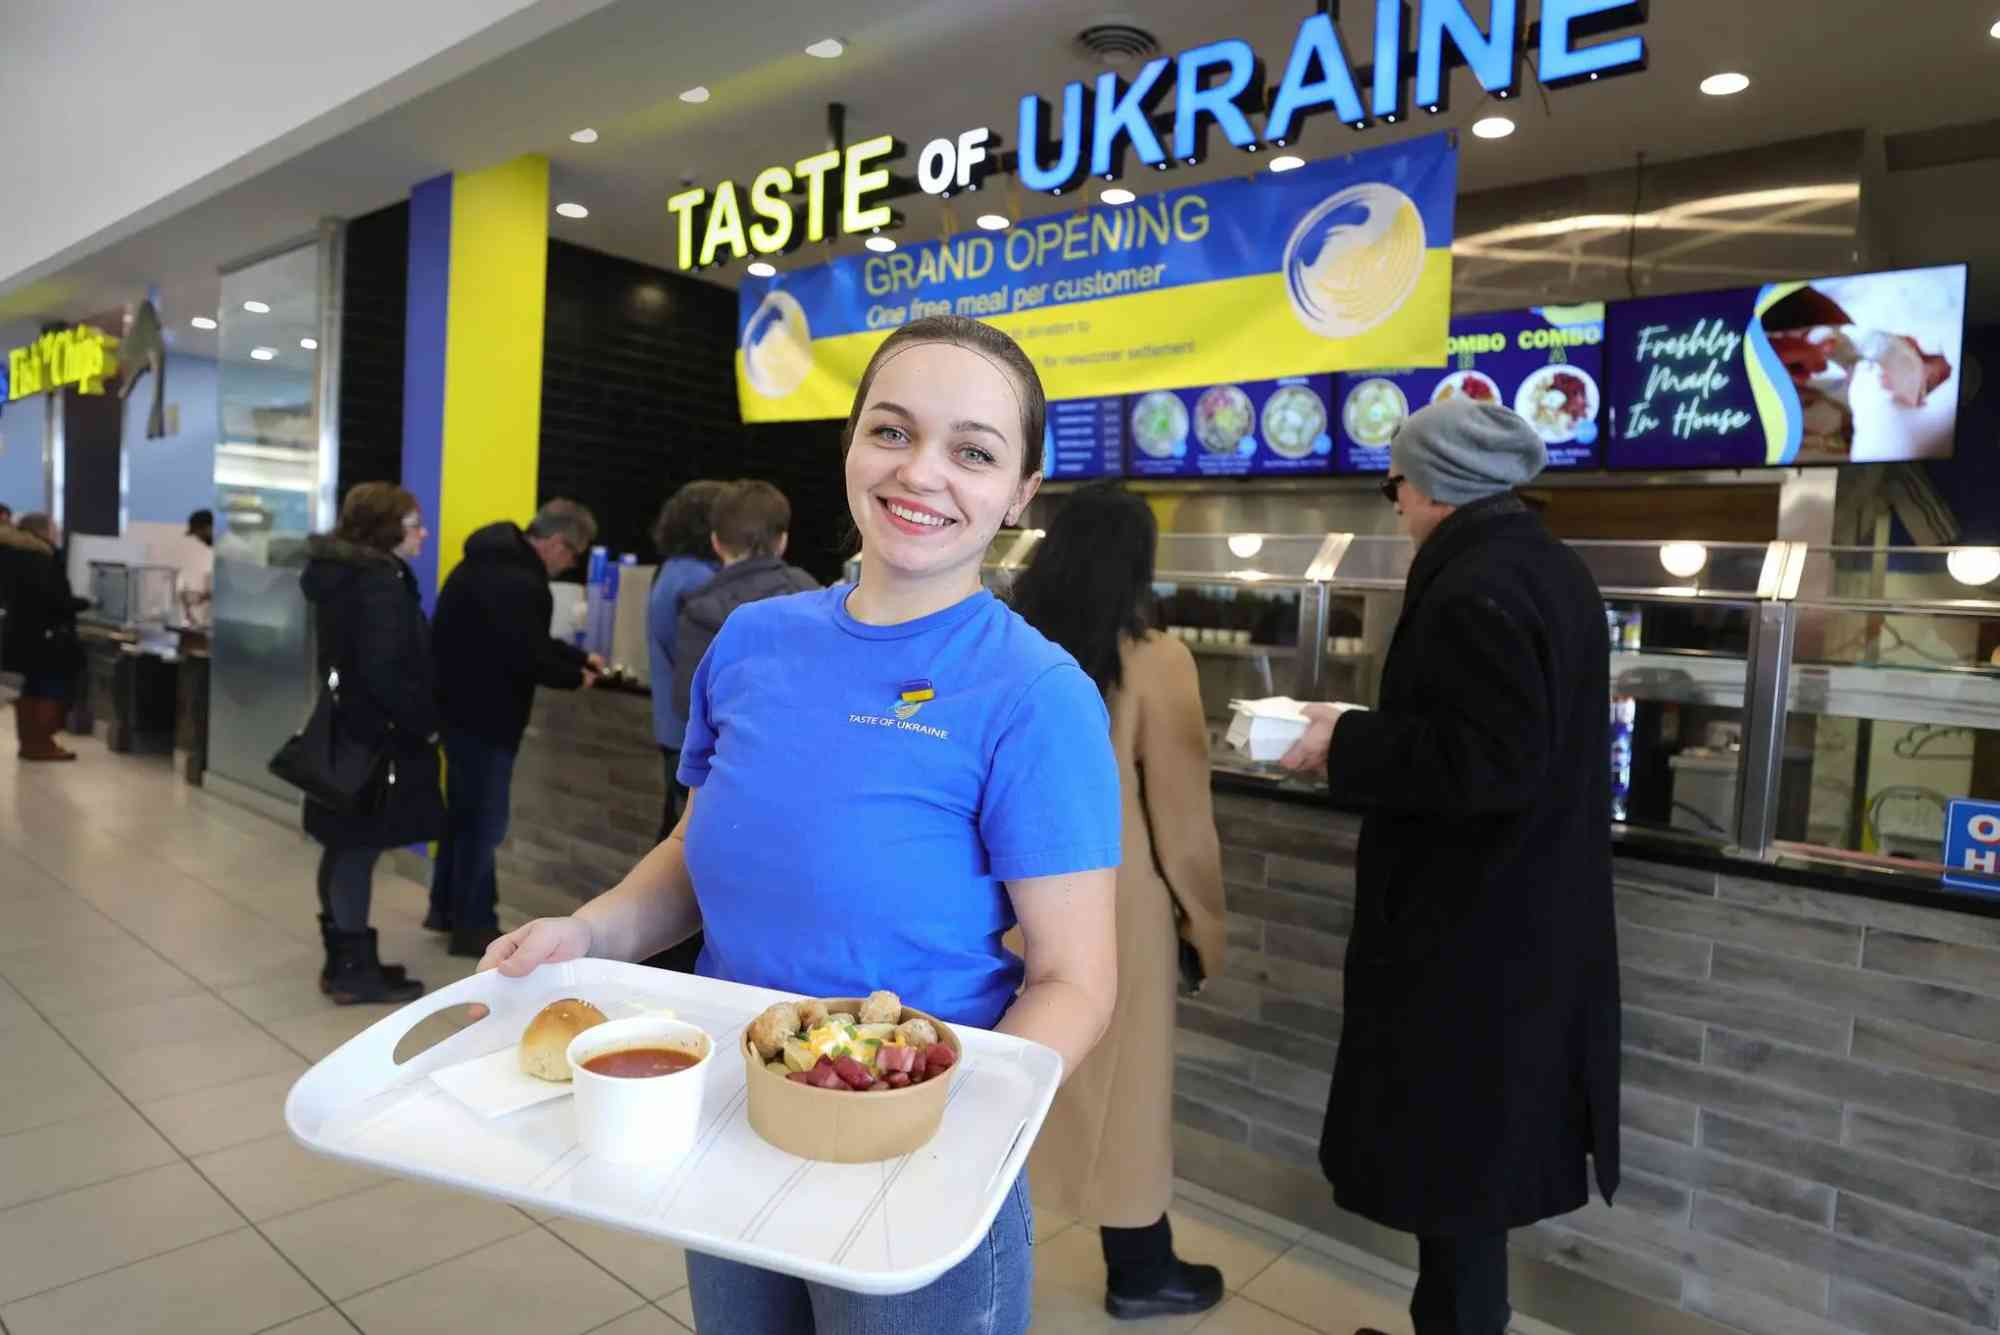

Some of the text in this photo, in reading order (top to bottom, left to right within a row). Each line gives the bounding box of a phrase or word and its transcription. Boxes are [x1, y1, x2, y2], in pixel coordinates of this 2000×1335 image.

[668, 0, 1643, 270] TASTE OF UKRAINE
[864, 195, 1210, 296] GRAND OPENING
[866, 304, 906, 328] One
[956, 284, 1008, 317] meal
[1013, 283, 1049, 314] per
[1053, 262, 1166, 301] customer
[1446, 332, 1507, 355] OMBO
[1517, 326, 1601, 350] COMBO
[1636, 317, 1741, 363] Freshly
[1644, 358, 1730, 400] Made
[1623, 401, 1660, 439] In
[1672, 395, 1752, 440] House
[848, 714, 949, 740] TASTE OF UKRAINE
